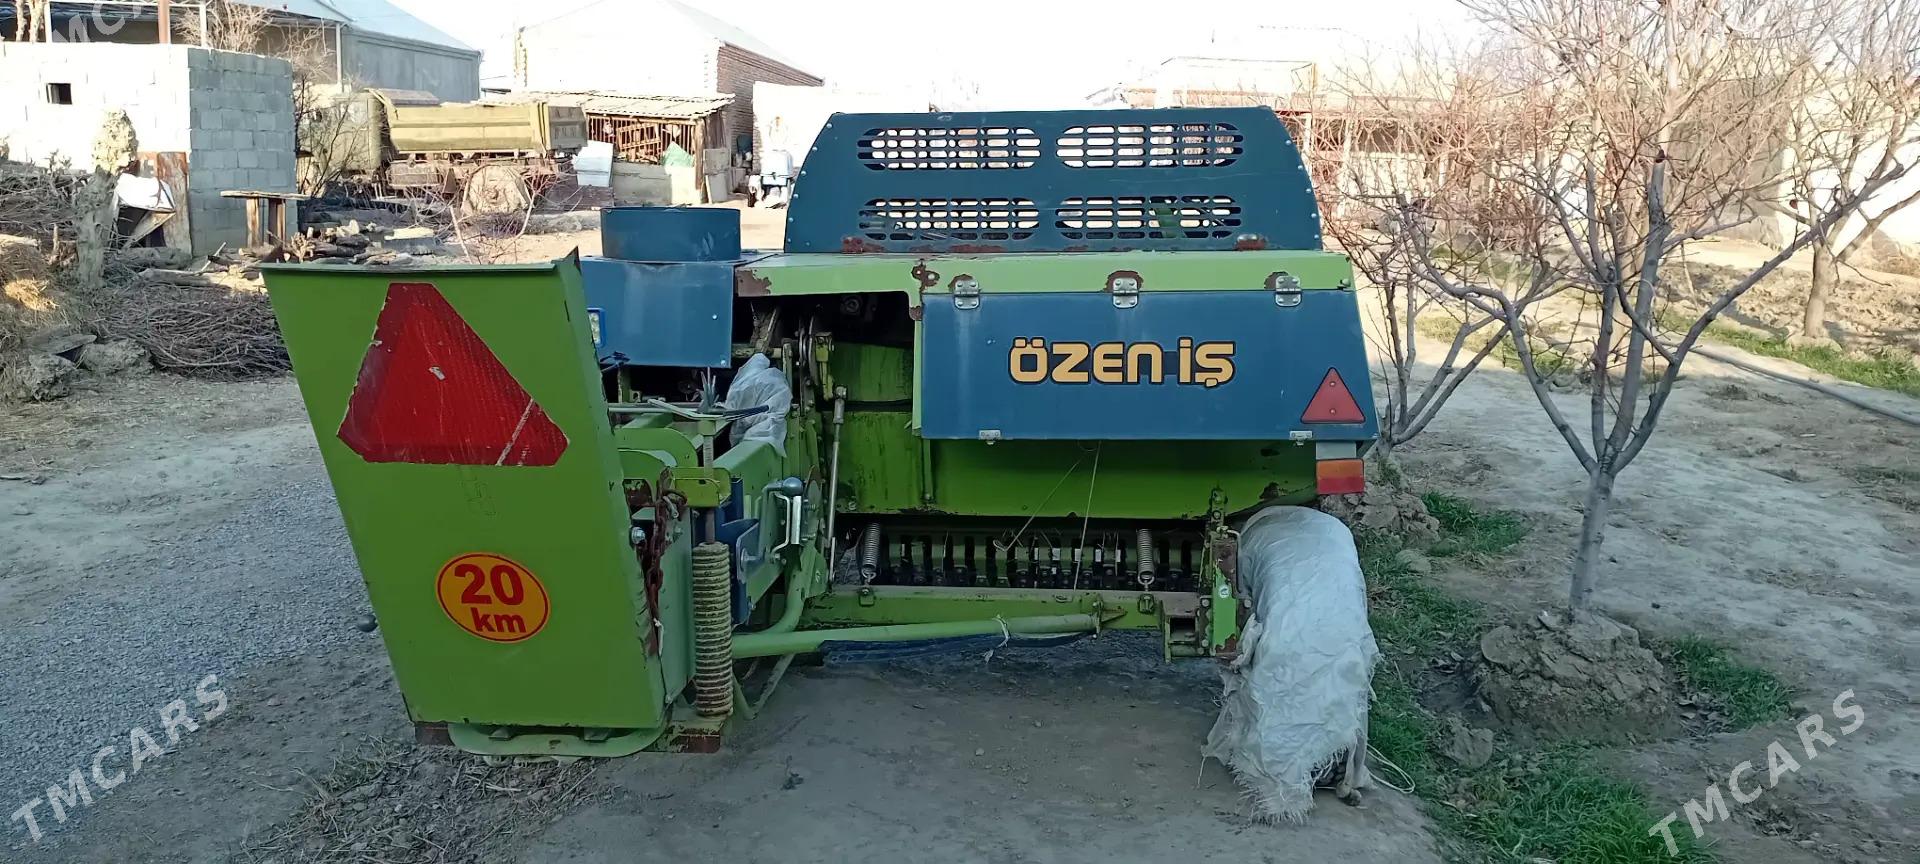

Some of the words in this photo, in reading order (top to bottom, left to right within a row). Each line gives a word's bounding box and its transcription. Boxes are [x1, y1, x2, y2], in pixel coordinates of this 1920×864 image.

[1009, 337, 1163, 384] ÖZEN
[454, 563, 524, 606] 20
[470, 607, 527, 633] km
